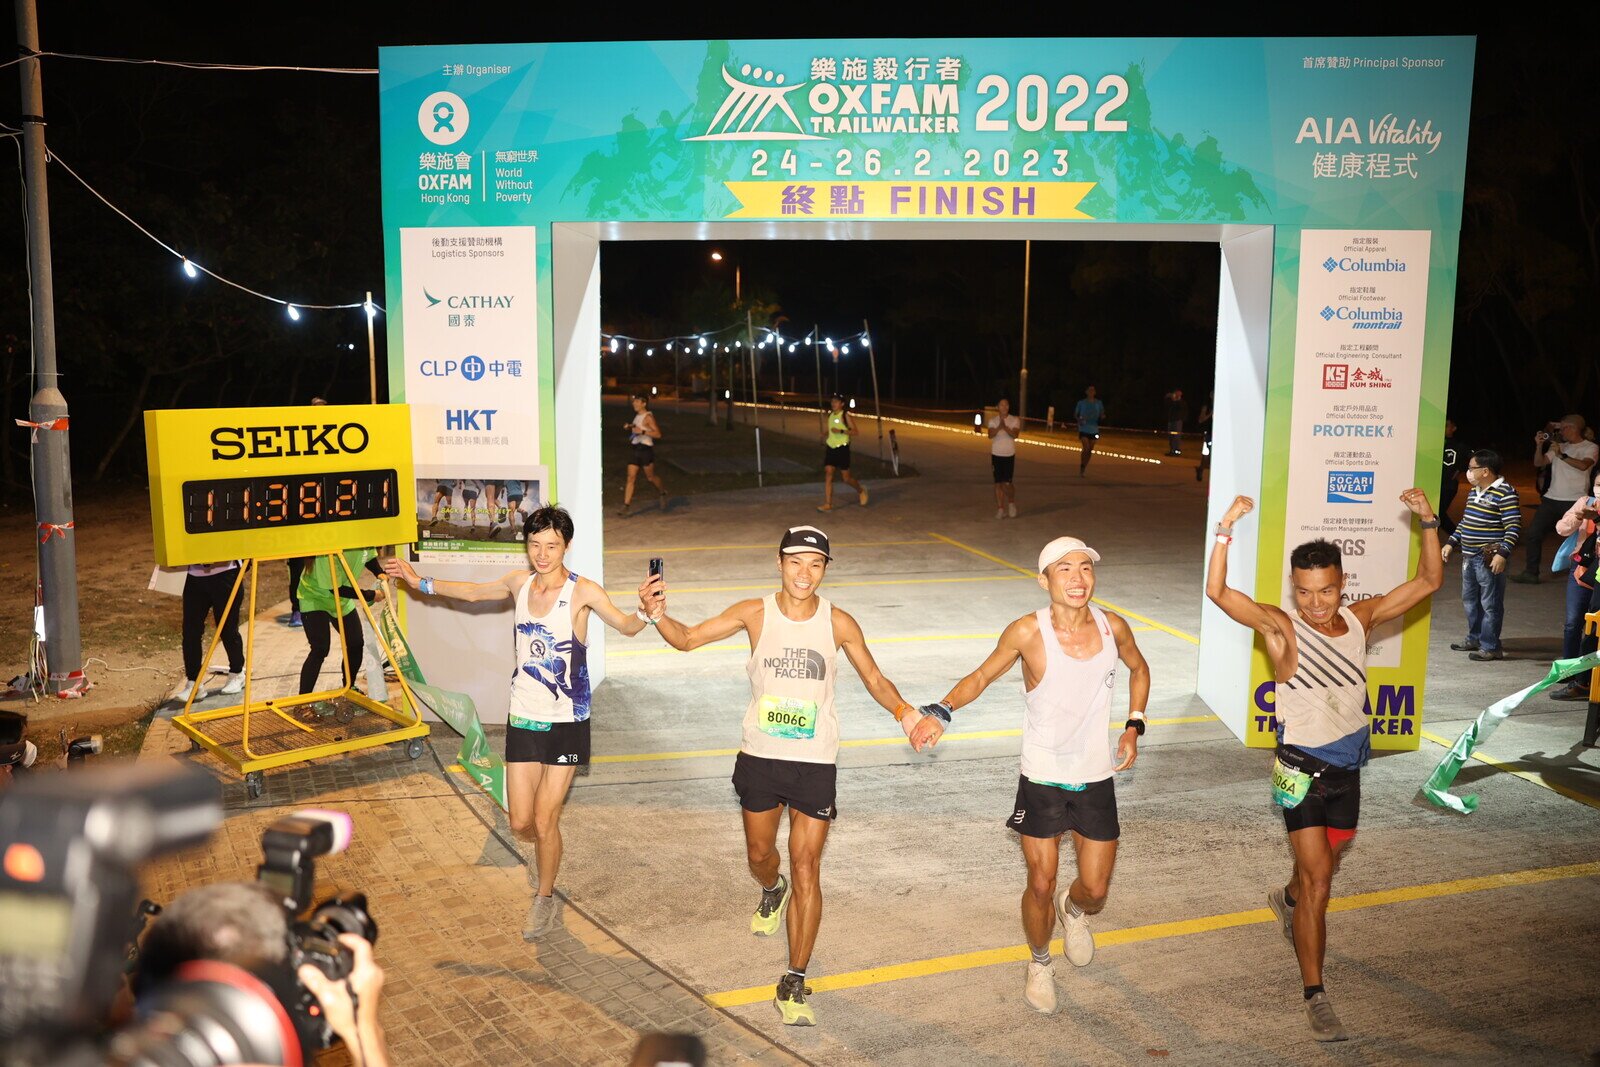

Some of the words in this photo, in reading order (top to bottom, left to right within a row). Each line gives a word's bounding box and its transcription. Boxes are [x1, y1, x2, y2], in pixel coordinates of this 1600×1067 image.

[442, 64, 464, 76] 主辦
[466, 64, 511, 76] Organiser
[811, 57, 962, 81] 樂施毅行者
[1303, 57, 1350, 69] 首席贊助
[1353, 57, 1399, 70] Principal
[1401, 57, 1445, 69] Sponsor
[809, 82, 960, 115] OXFAM
[975, 74, 1129, 132] 2022
[811, 116, 960, 134] TRAILWALKER
[1295, 117, 1362, 144] AIA
[1369, 113, 1443, 155] Vitality
[419, 151, 472, 170] 樂施會
[495, 150, 539, 163] 無窮世界
[1312, 152, 1418, 179] 健康程式
[495, 168, 522, 178] World
[418, 174, 472, 190] OXFAM
[495, 180, 533, 190] Without
[421, 193, 445, 205] Hong
[447, 193, 470, 205] Kong
[496, 192, 532, 204] Poverty
[781, 185, 865, 214] 終點
[890, 186, 1036, 215] FINISH
[431, 237, 503, 247] 後勤支援贊助機構
[431, 249, 467, 259] Logistics
[469, 249, 505, 259] Sponsors
[1343, 245, 1364, 253] Official
[1365, 245, 1387, 254] Apparel
[1338, 257, 1406, 272] Columbia
[447, 295, 515, 309] CATHAY
[1338, 294, 1359, 302] Official
[1360, 294, 1387, 302] Footwear
[1336, 306, 1403, 321] Columbia
[448, 314, 476, 327] 國泰
[1351, 321, 1403, 330] montrail
[1336, 352, 1370, 360] Engineering
[419, 360, 458, 377] CLP
[489, 360, 522, 377] 中電
[1350, 367, 1383, 382] 金城
[446, 410, 498, 431] HKT
[1370, 413, 1384, 421] Shop
[1313, 424, 1385, 437] PROTREK
[210, 422, 369, 460] SEIKO
[1329, 476, 1373, 485] POCARI
[1329, 484, 1368, 492] SWEAT
[783, 647, 806, 659] THE
[763, 657, 806, 669] NORTH
[774, 668, 805, 679] FACE
[767, 711, 806, 727] 8006C
[567, 754, 578, 762] T8
